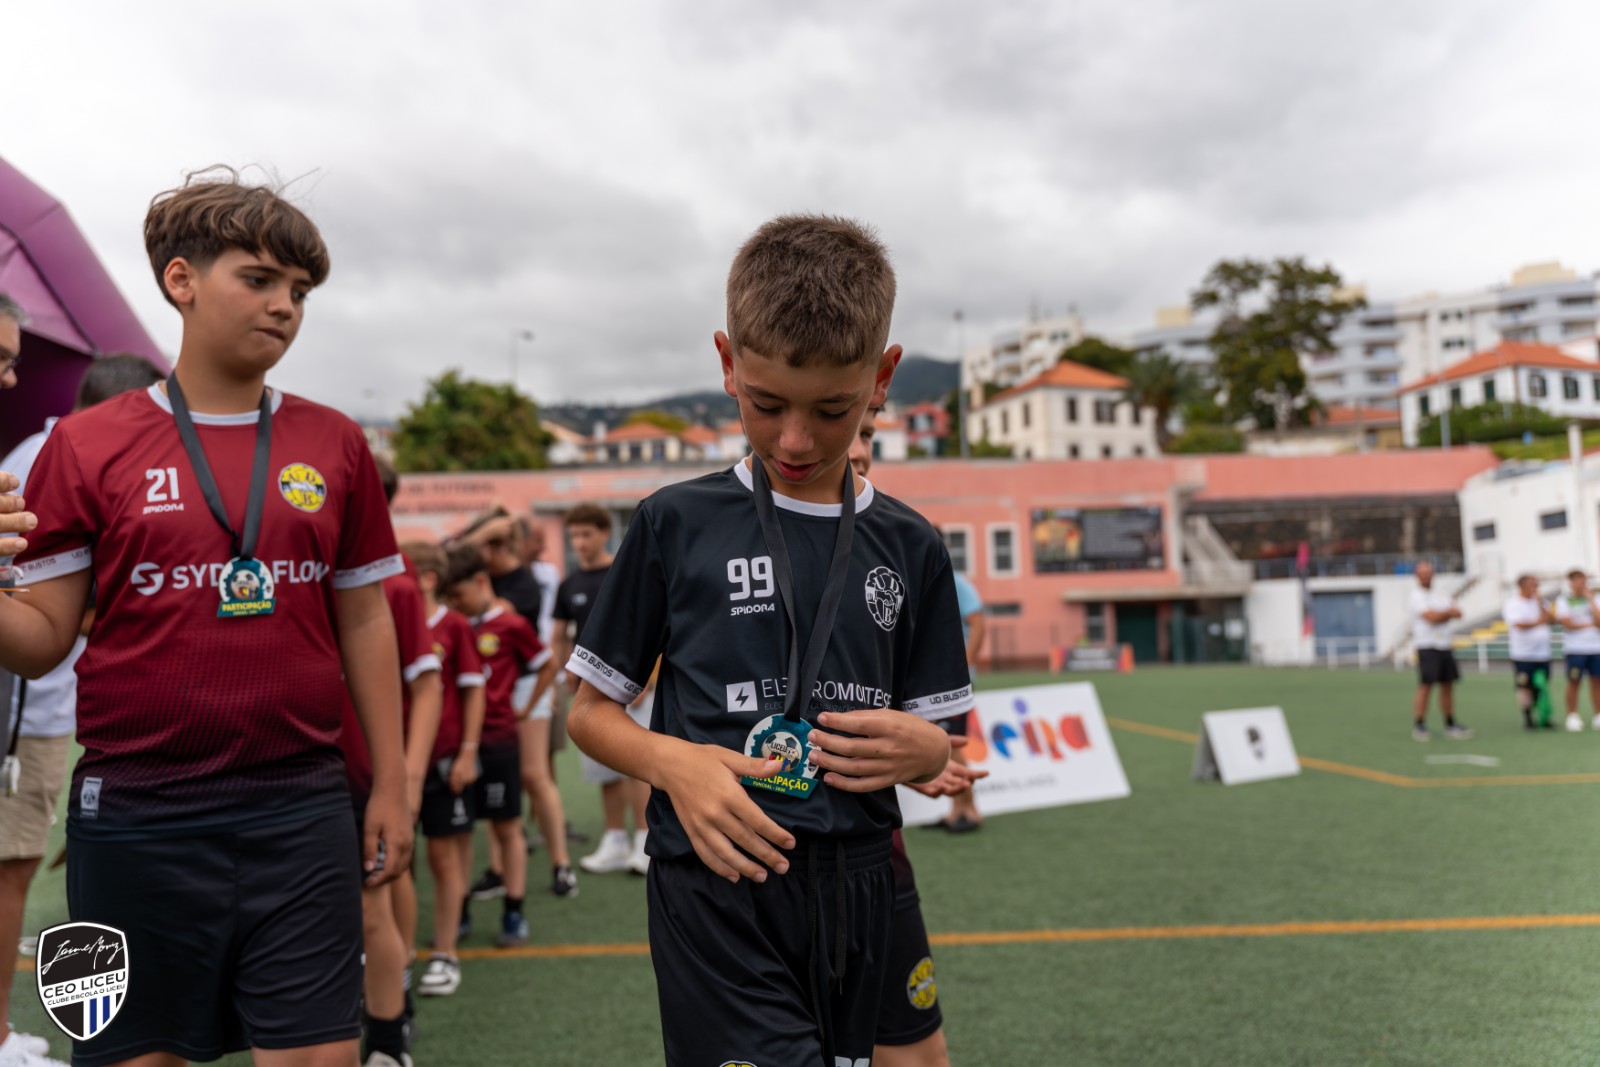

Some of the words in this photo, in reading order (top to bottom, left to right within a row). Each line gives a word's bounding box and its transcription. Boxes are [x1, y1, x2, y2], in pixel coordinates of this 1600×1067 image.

[146, 467, 180, 503] 21
[142, 503, 185, 515] SPIDORA
[727, 555, 775, 601] 99
[730, 603, 775, 616] SPIDORA
[576, 648, 588, 660] UD
[587, 656, 614, 678] BUSTOS
[929, 696, 942, 705] UD
[942, 688, 969, 703] BUSTOS
